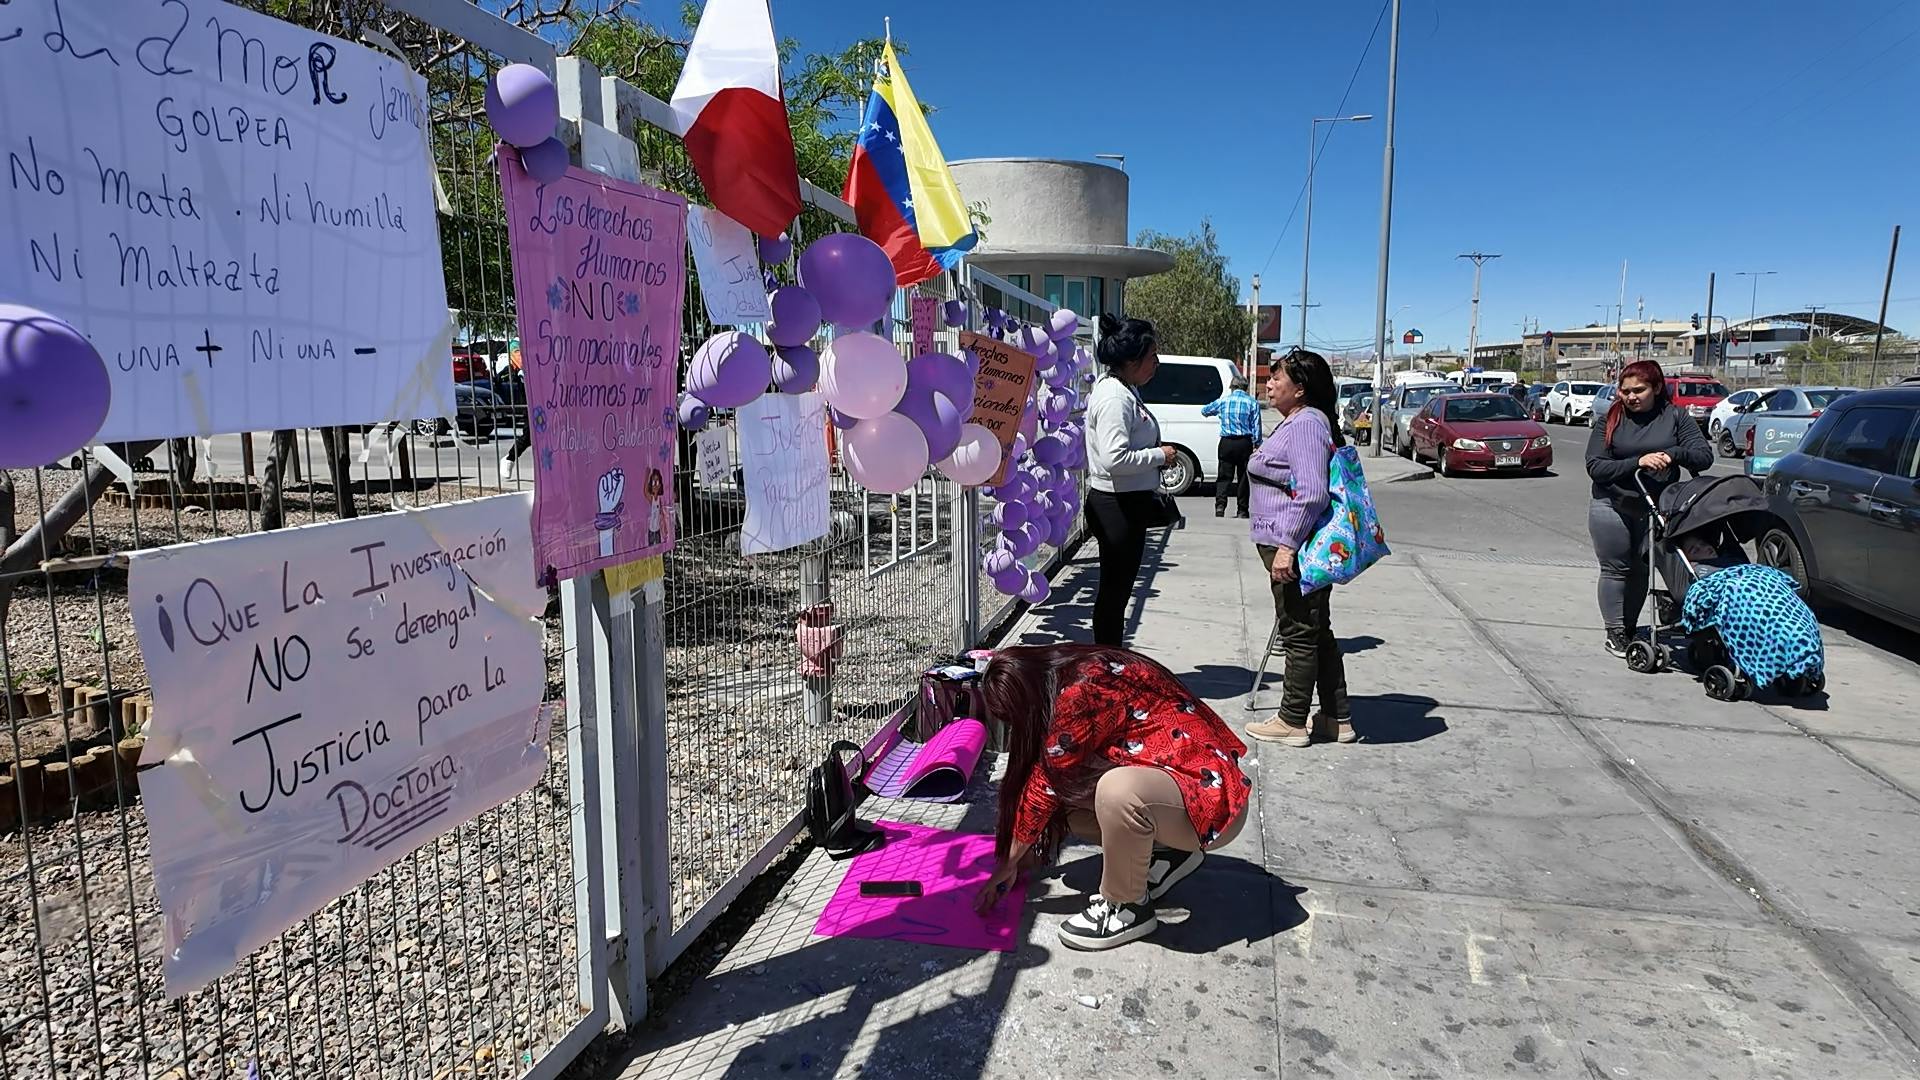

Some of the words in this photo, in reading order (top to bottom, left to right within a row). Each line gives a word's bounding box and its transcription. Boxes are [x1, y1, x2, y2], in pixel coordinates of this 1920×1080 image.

[157, 97, 291, 152] GOLPEA
[9, 136, 65, 195] No
[260, 173, 292, 228] Ni
[305, 182, 407, 233] humilla
[530, 184, 574, 235] Los
[578, 195, 653, 242] derechos
[30, 232, 83, 282] Ni
[576, 234, 667, 286] Humanos
[571, 280, 615, 322] NO
[252, 329, 285, 363] Ni
[536, 319, 572, 366] Son
[578, 324, 663, 380] opcionales
[968, 339, 1008, 364] derechos
[546, 363, 626, 410] Luchemos
[631, 386, 653, 422] por
[974, 395, 1019, 416] cionales
[1779, 431, 1803, 439] Servici
[283, 561, 323, 613] La
[247, 634, 311, 704] NO
